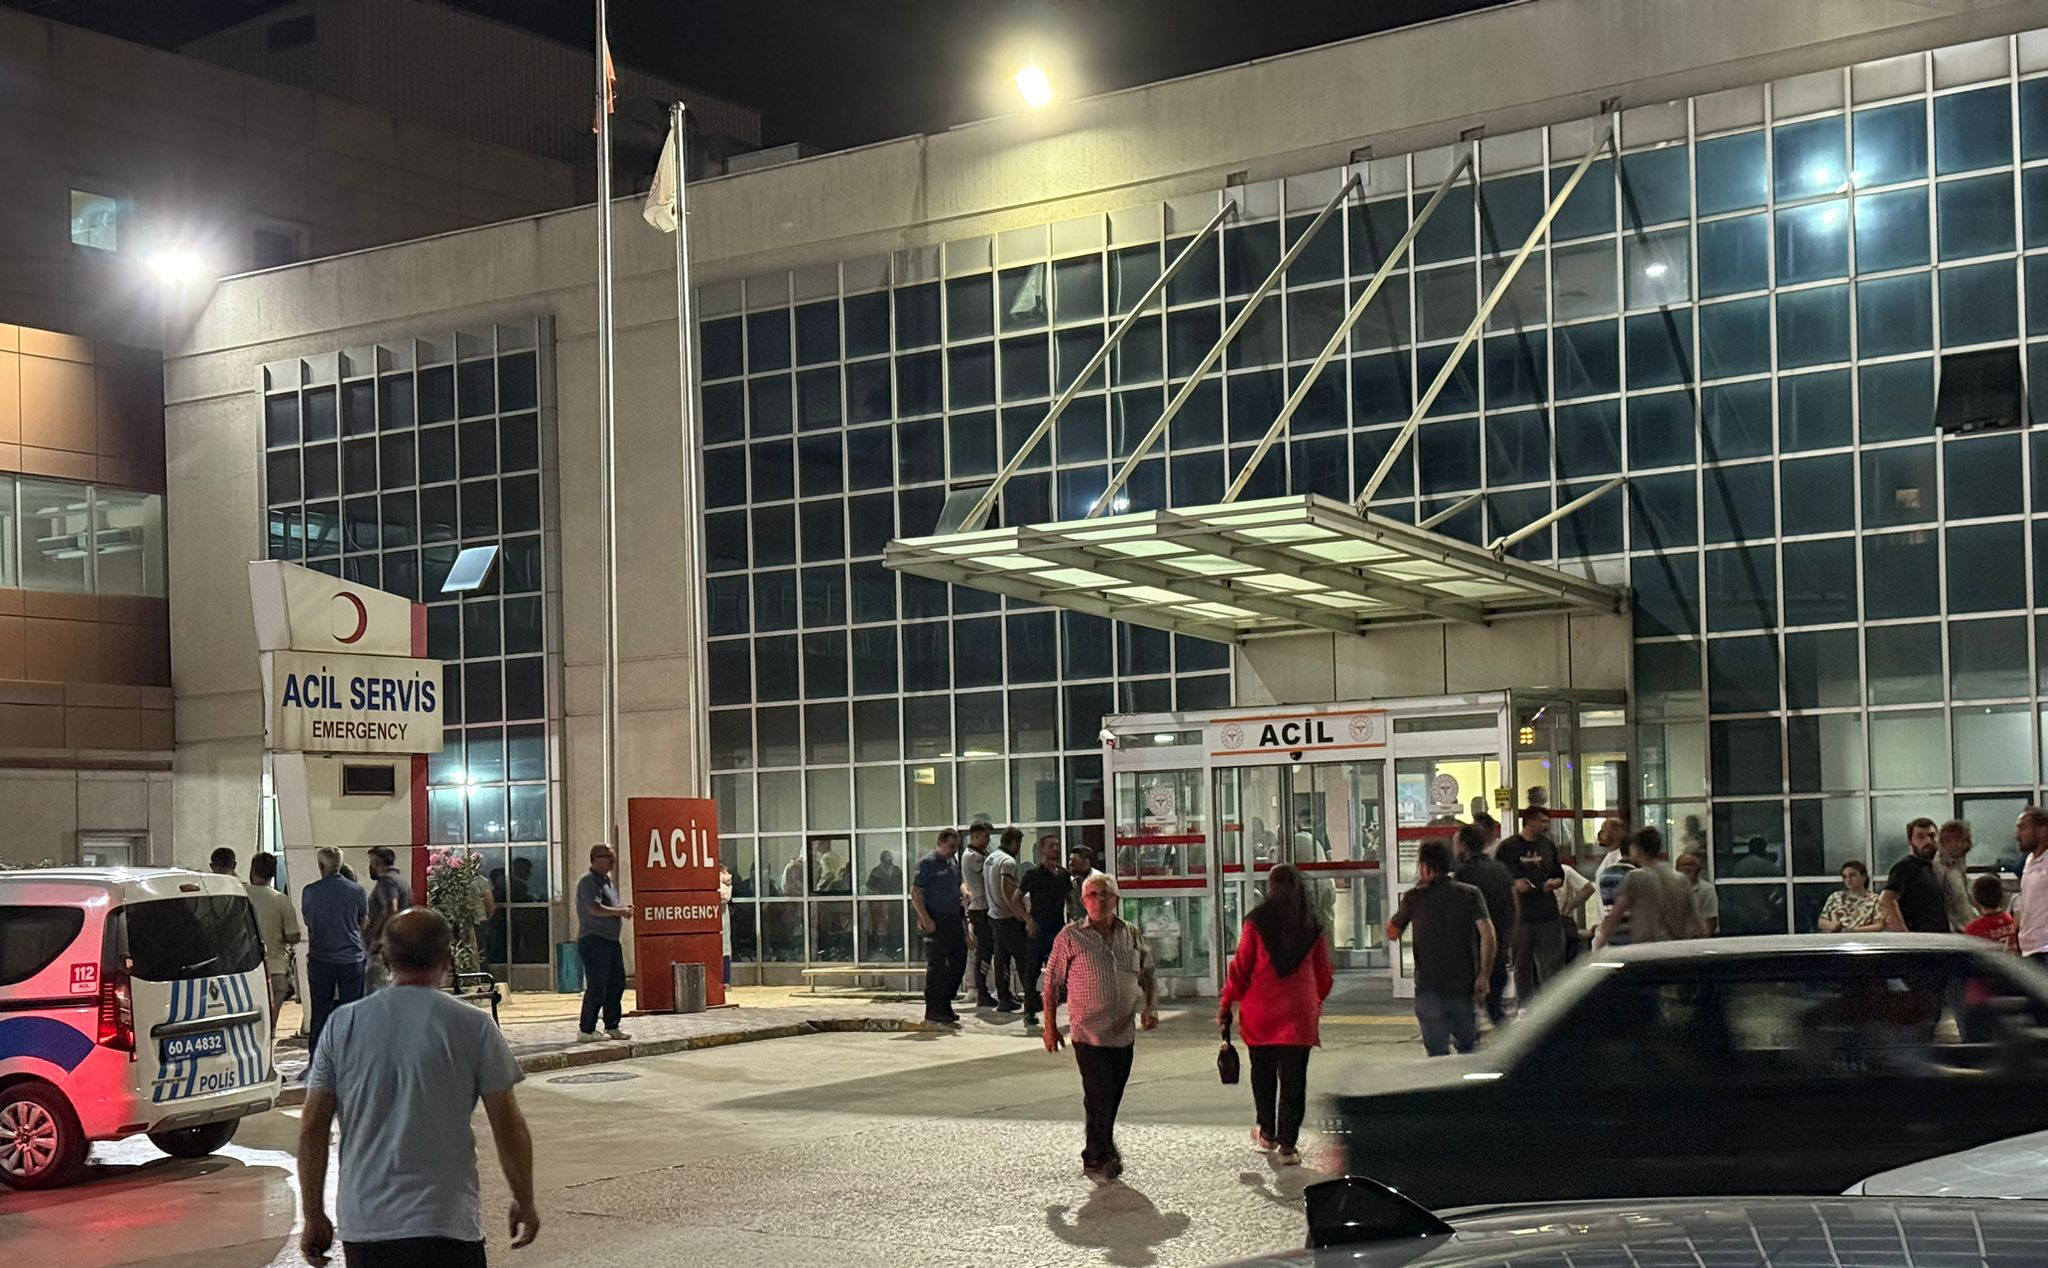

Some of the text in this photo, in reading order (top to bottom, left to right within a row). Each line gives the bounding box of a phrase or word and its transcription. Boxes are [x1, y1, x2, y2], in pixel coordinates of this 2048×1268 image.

[282, 665, 436, 713] ACİL SERVİS
[312, 720, 408, 741] EMERGENCY
[1258, 718, 1334, 747] ACİL
[646, 819, 715, 868] ACİL
[644, 905, 720, 921] EMERGENCY
[74, 965, 95, 982] 112
[168, 1035, 222, 1055] 60 A 4832
[200, 1067, 235, 1091] POLİS
